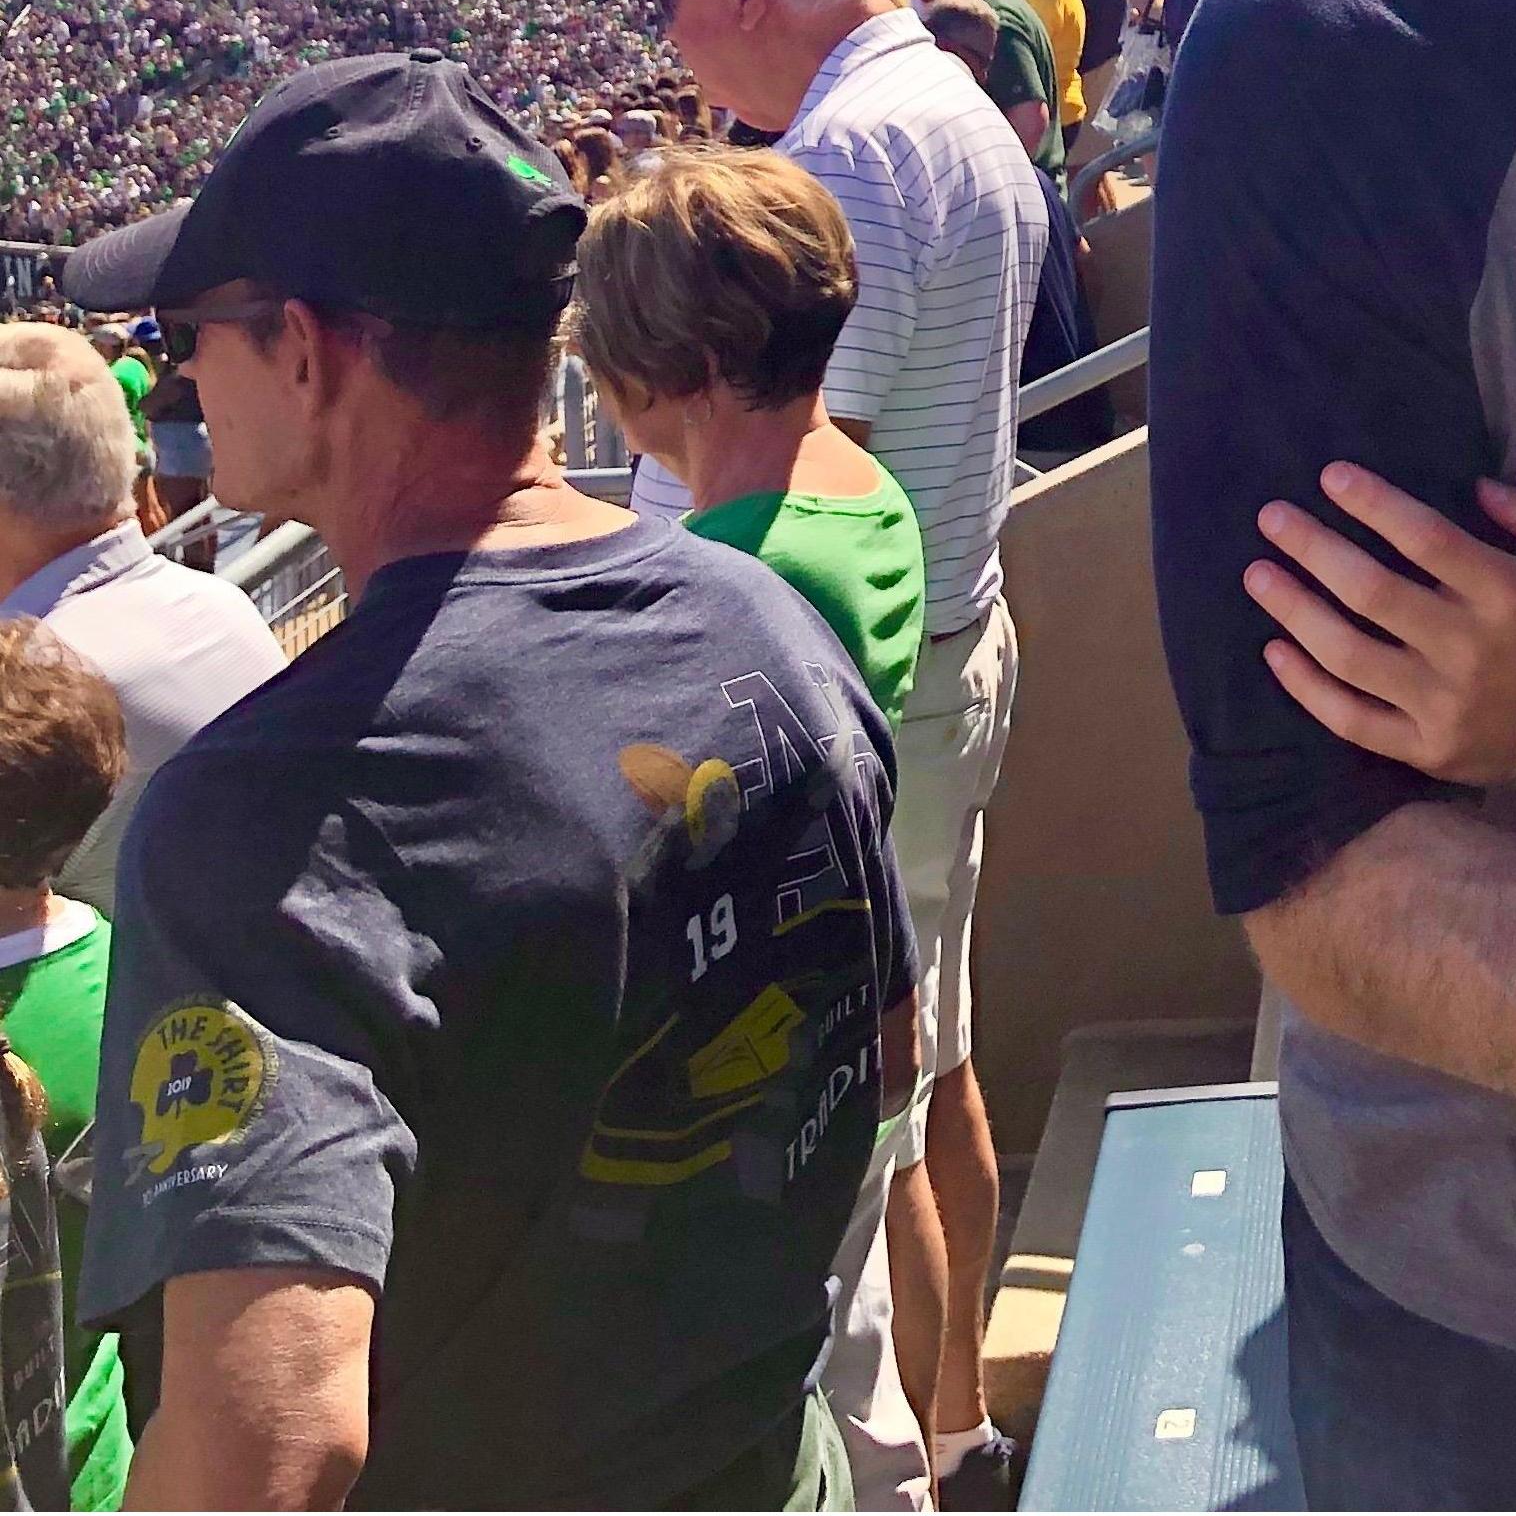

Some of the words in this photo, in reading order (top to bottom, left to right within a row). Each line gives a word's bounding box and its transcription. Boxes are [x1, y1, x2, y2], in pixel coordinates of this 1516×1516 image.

[686, 892, 738, 983] 19
[157, 1015, 208, 1050] THE
[206, 1026, 251, 1114] SHIRT
[166, 1076, 193, 1097] 2019
[153, 1164, 229, 1197] ANNIVERSARY
